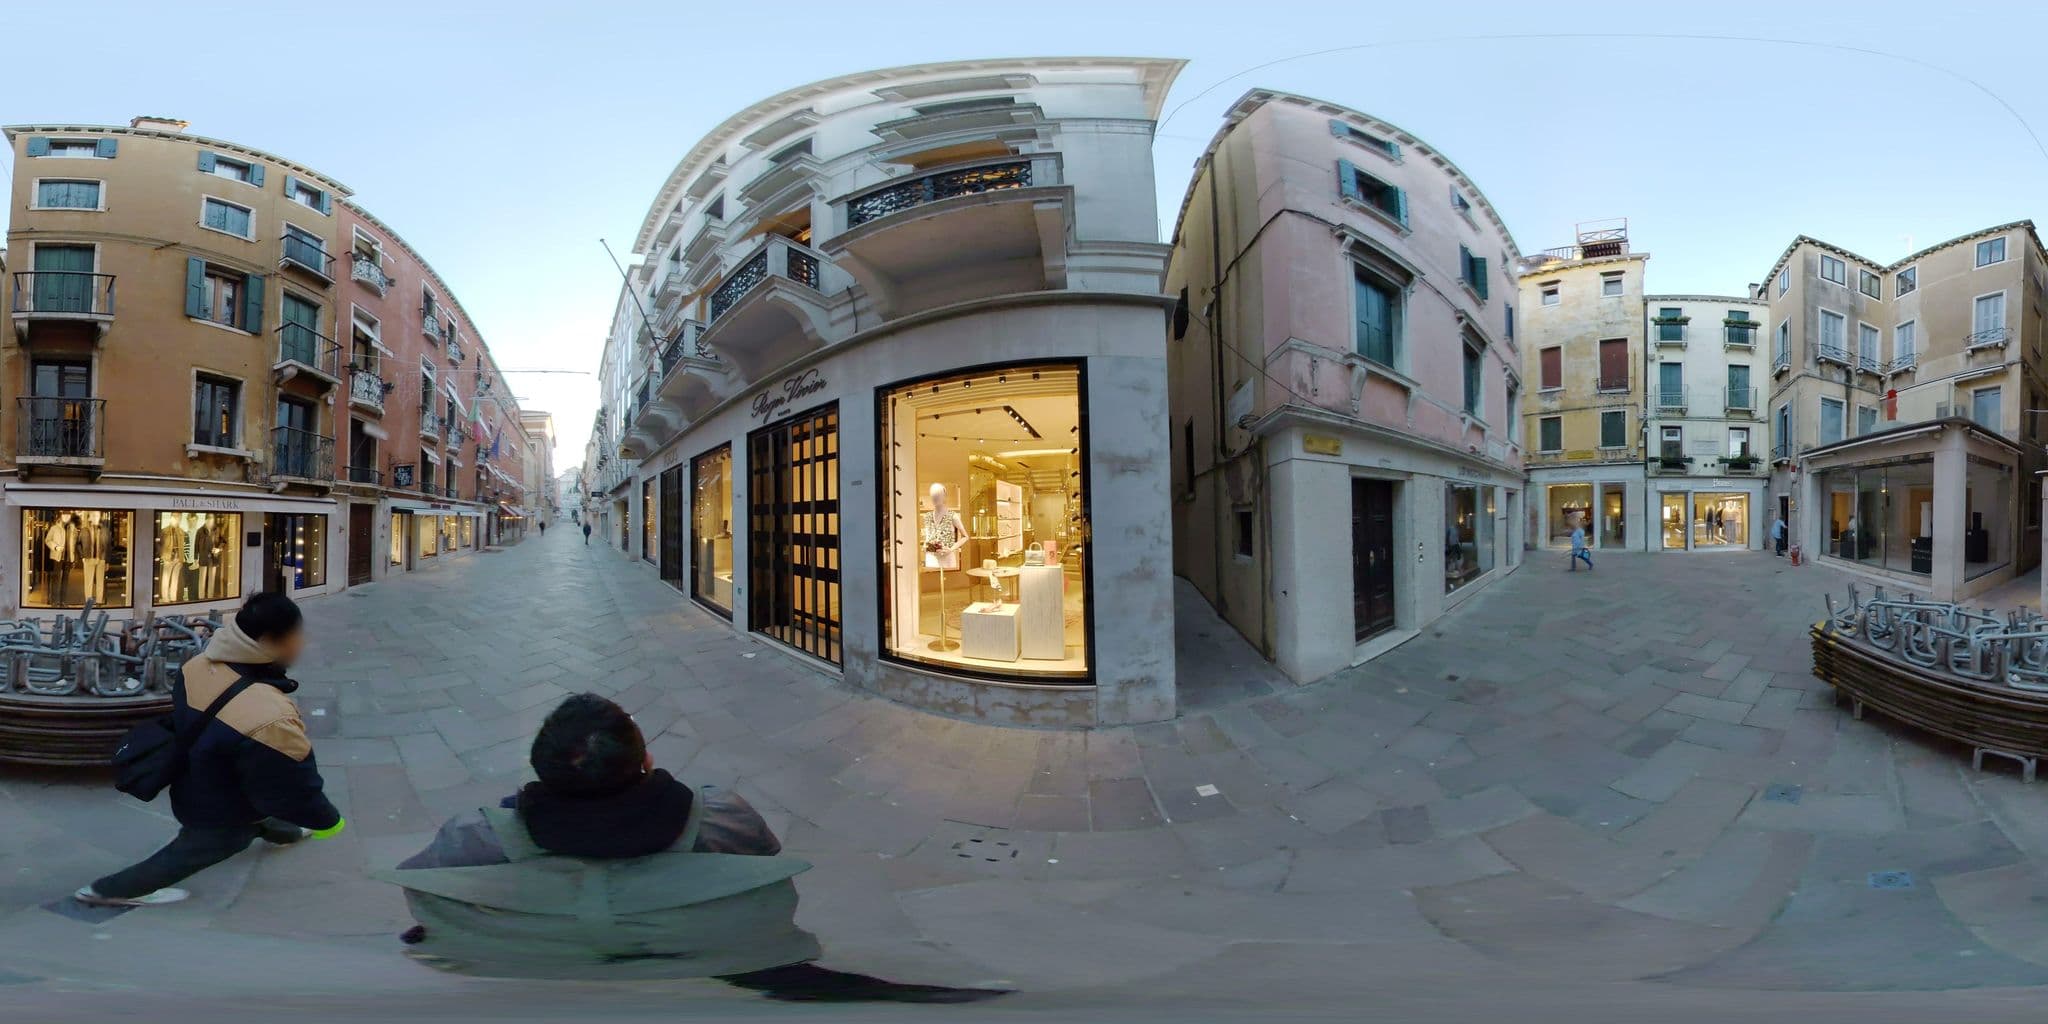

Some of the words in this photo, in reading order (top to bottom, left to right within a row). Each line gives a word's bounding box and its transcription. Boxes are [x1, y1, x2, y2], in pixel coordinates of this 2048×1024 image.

[751, 390, 786, 424] Roger
[784, 368, 827, 403] Vivier
[173, 498, 197, 508] PAUL
[207, 499, 240, 509] SHARK
